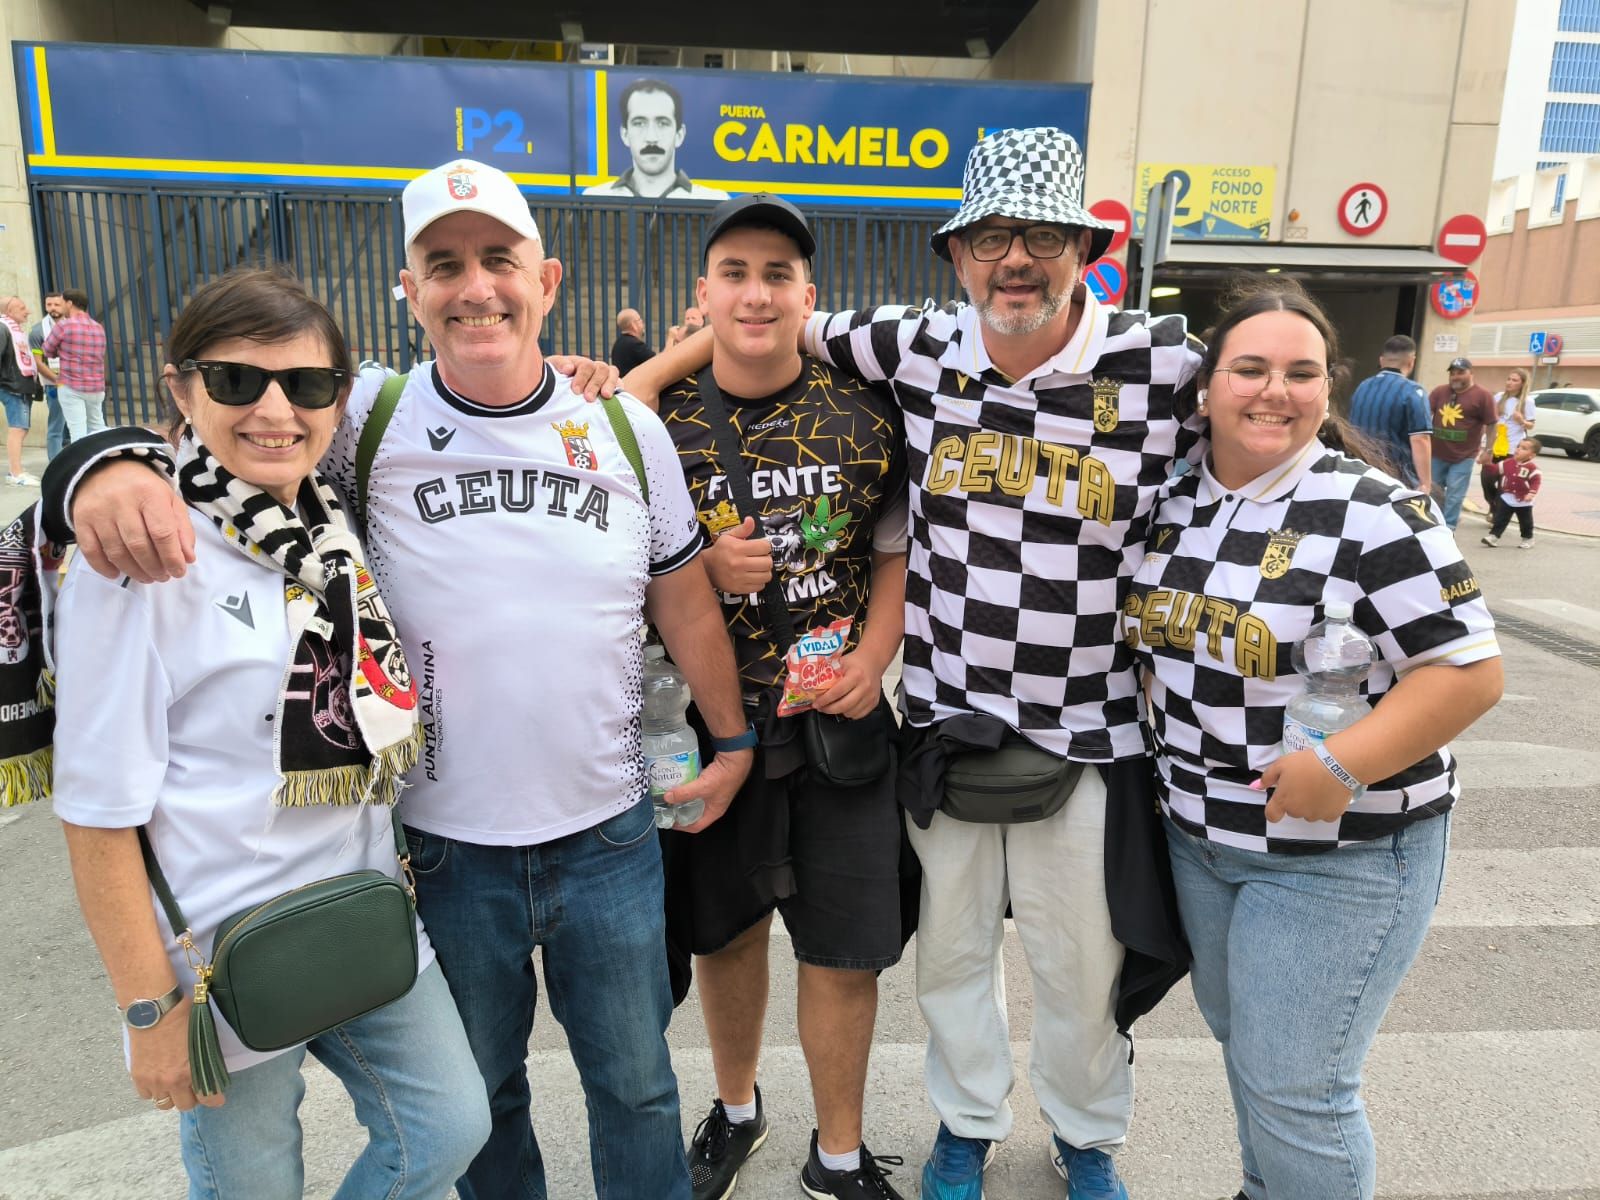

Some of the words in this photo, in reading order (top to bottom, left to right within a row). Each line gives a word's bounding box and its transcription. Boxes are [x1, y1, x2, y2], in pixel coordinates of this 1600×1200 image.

[720, 104, 766, 119] PUERTA
[713, 120, 949, 169] CARMELO
[1211, 181, 1263, 196] FONDO
[1212, 168, 1251, 178] ACCESO
[1164, 169, 1191, 216] 2
[1209, 199, 1258, 214] NORTE
[1259, 225, 1269, 239] 2
[708, 464, 842, 500] FENTE
[927, 431, 1116, 528] CEUTA
[413, 469, 610, 533] CEUTA
[1440, 577, 1480, 603] BALEA
[803, 639, 838, 653] VIDAL
[1120, 590, 1278, 683] CEUTA
[422, 640, 435, 718] ALMINA
[435, 688, 444, 753] PROMOCIONES
[423, 722, 438, 782] PUNTA
[1323, 755, 1334, 766] AD
[1330, 763, 1351, 783] CEUTA
[1346, 779, 1357, 788] FC
